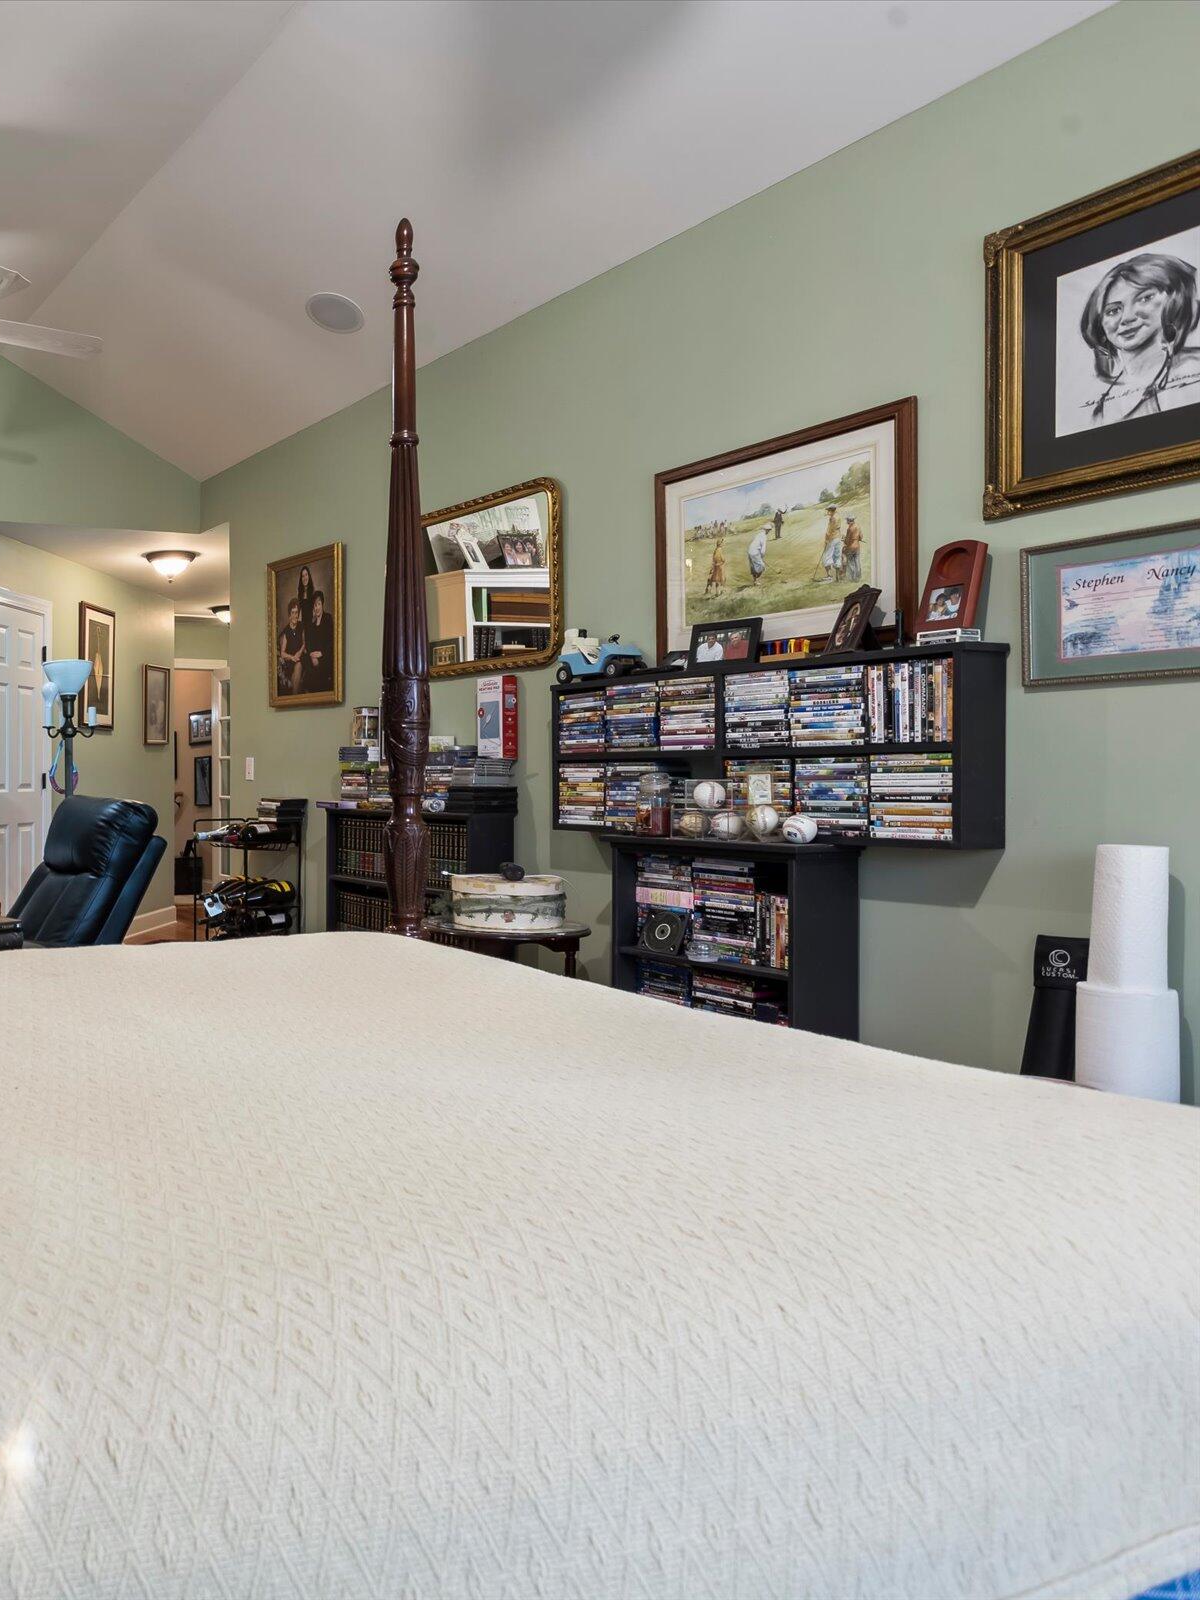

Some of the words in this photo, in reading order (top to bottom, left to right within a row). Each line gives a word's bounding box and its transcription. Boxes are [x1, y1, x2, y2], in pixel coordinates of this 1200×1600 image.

[1072, 573, 1125, 591] Stephen
[1147, 564, 1197, 580] Nancy
[1041, 966, 1076, 974] LUCASI
[1041, 971, 1075, 979] CUSTOM
